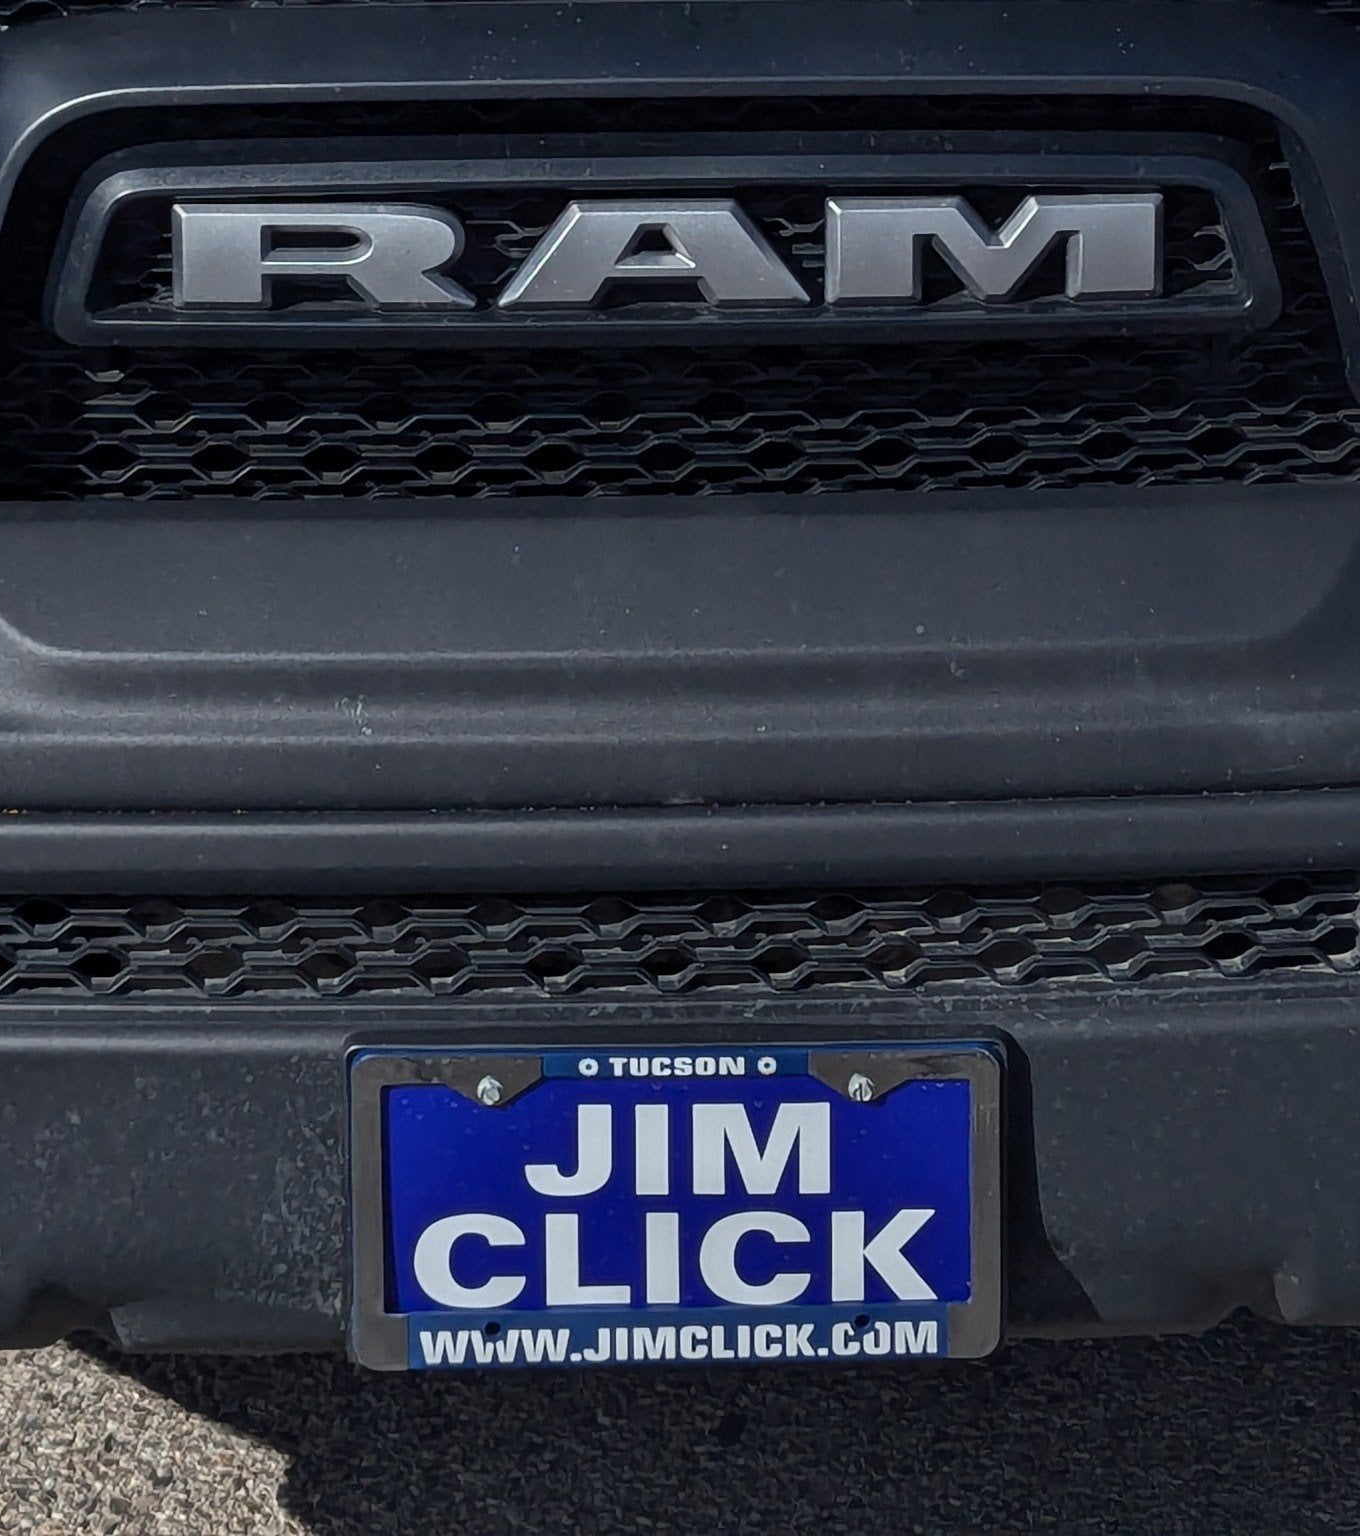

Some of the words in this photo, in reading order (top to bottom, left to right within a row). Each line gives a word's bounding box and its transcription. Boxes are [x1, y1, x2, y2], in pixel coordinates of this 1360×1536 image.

[172, 192, 1164, 308] RAM
[609, 1056, 745, 1077] TUCSON
[524, 1101, 831, 1197] JIM
[413, 1209, 938, 1309] CLICK
[419, 1320, 938, 1365] WWW.JIMCLICK.COM
